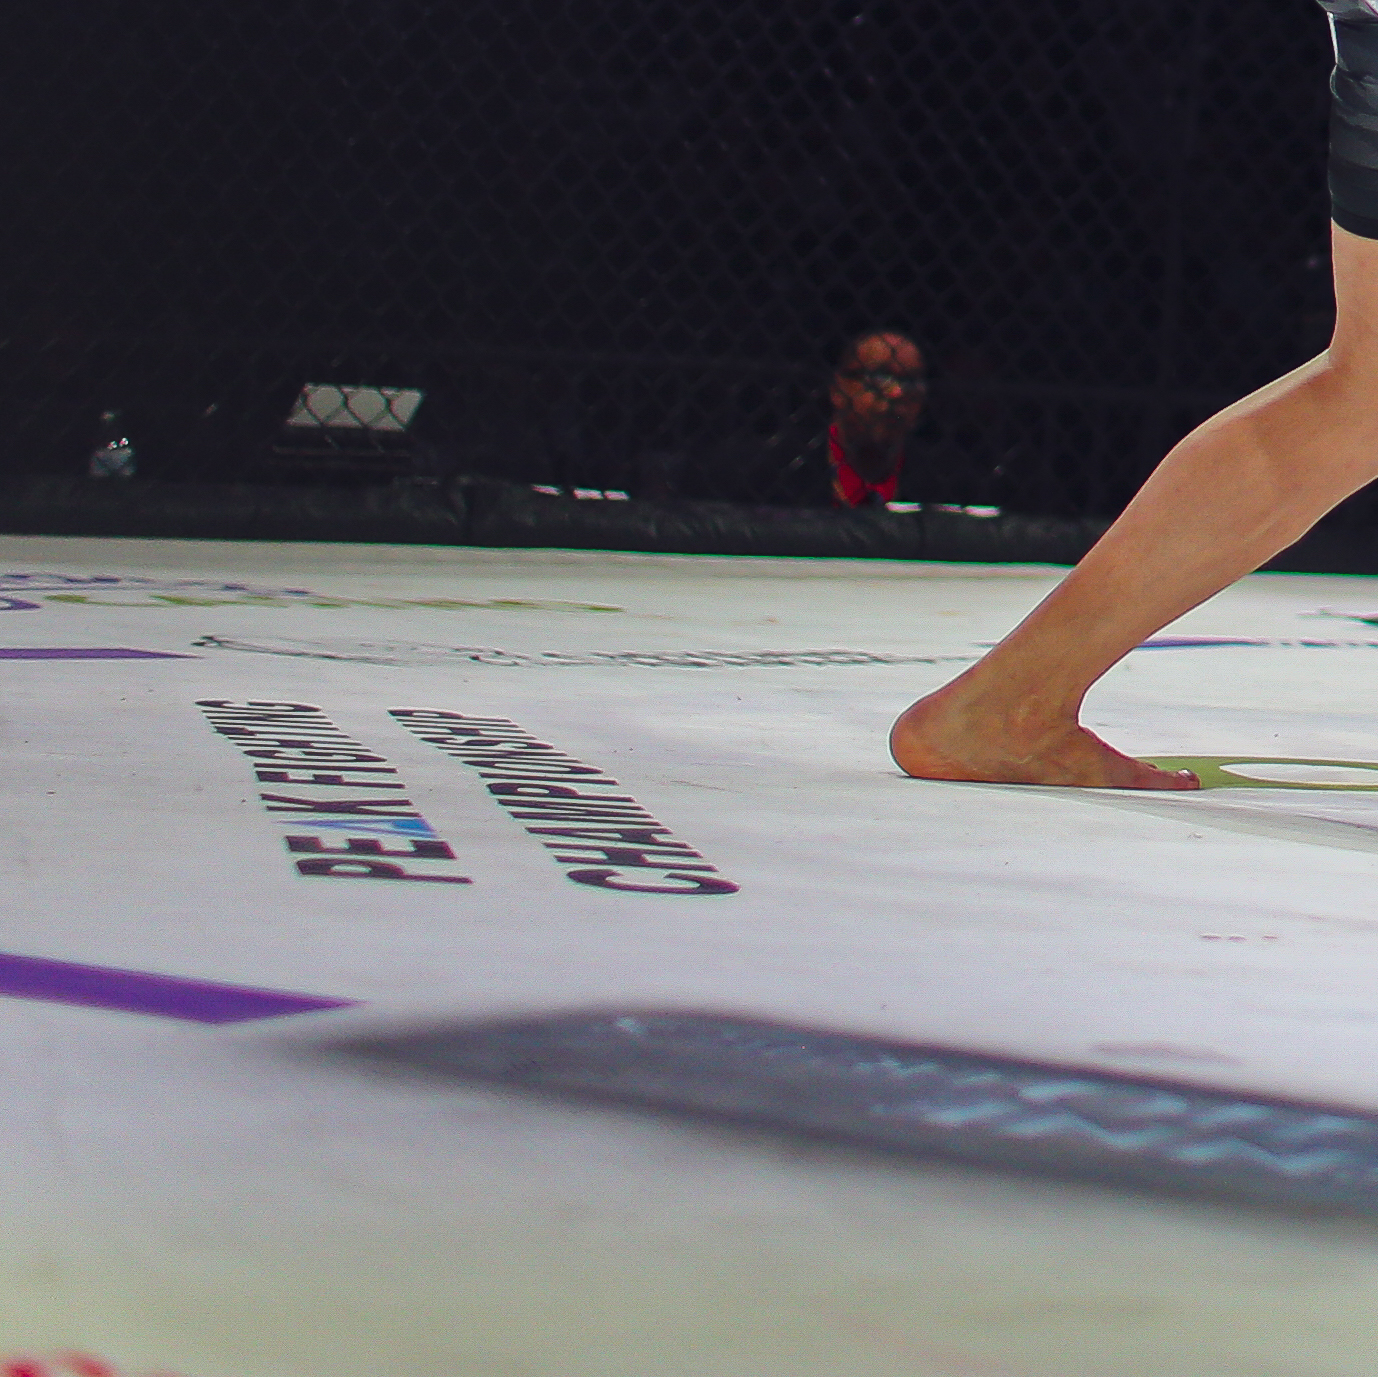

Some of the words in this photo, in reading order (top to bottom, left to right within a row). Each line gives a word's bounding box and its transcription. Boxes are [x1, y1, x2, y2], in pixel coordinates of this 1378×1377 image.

[194, 699, 407, 790] FIGHTING
[257, 792, 476, 885] PEAK
[387, 707, 742, 895] CHAMPIONSHIP
